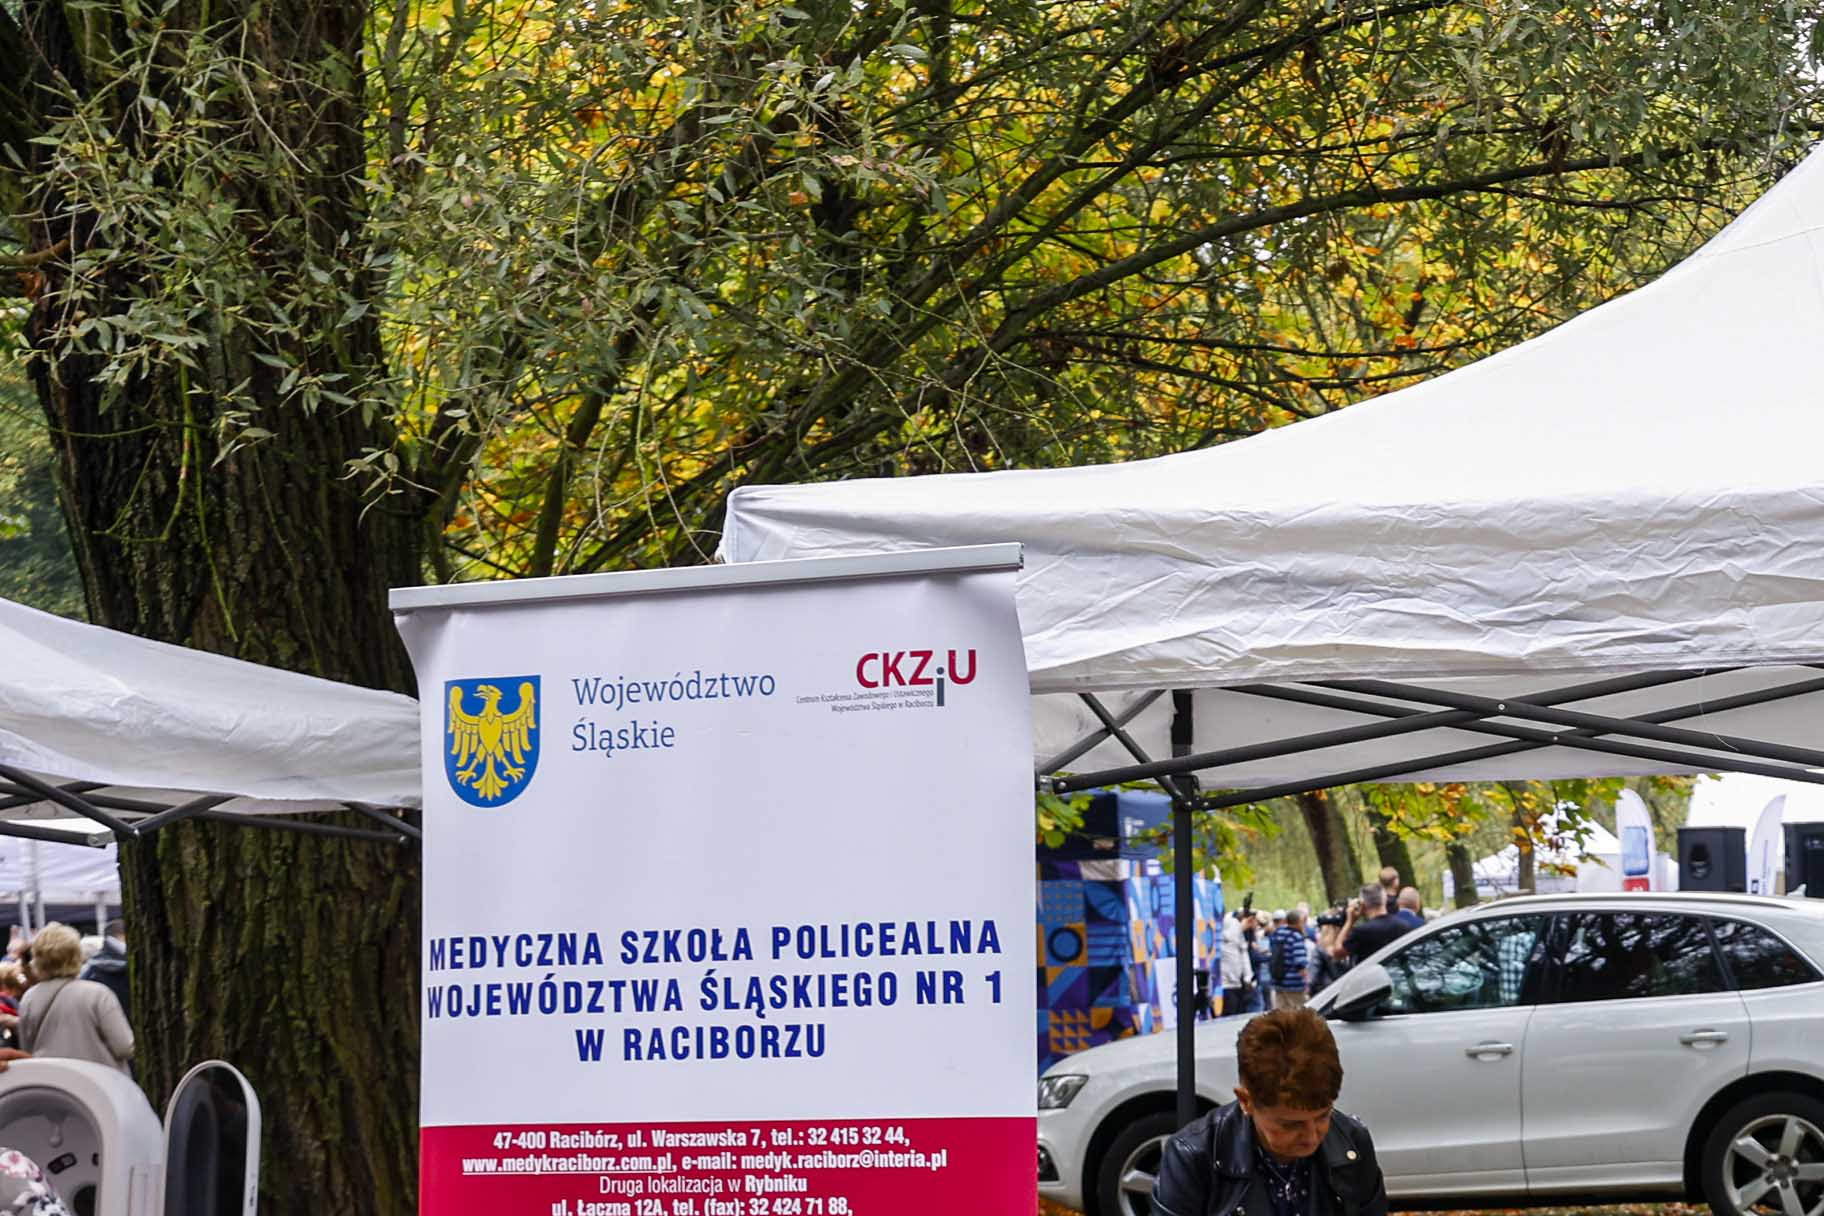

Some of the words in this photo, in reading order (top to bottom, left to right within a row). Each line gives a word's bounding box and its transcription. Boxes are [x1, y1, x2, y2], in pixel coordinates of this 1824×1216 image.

[572, 671, 775, 711] Województwo
[855, 648, 977, 707] CKZiU
[573, 718, 674, 758] Śląskie
[430, 933, 603, 971] MEDYCZNA
[621, 928, 753, 964] SZKOŁA
[772, 920, 1001, 959] POLICEALNA
[428, 973, 682, 1018] WOJEWÓDZTWA
[700, 969, 897, 1019] ŚLĄSKIEGO
[917, 971, 964, 1004] NR
[986, 971, 1000, 1003] 1
[576, 1029, 604, 1061] W
[624, 1024, 824, 1060] RACIBORZU
[494, 1132, 546, 1149] 47-400
[550, 1130, 623, 1150] Racibórz,
[628, 1130, 647, 1147] ul.
[652, 1129, 746, 1147] Warszawska
[750, 1129, 766, 1148] 7,
[771, 1128, 803, 1145] tel.:
[808, 1128, 827, 1145] 32
[830, 1127, 858, 1144] 415
[863, 1127, 881, 1144] 32
[885, 1127, 909, 1146] 44,
[463, 1153, 677, 1175] www.medykraciborz.com.pl,
[682, 1152, 736, 1170] e-mail:
[741, 1149, 947, 1172] medyk.raciborz@interia.pl
[600, 1176, 643, 1197] Druga
[648, 1176, 723, 1196] lokalizacja
[728, 1179, 741, 1192] w
[745, 1174, 807, 1196] Rybniku
[552, 1200, 572, 1216] ul.
[673, 1198, 699, 1216] tel.
[749, 1198, 769, 1215] 32
[773, 1198, 800, 1215] 424
[800, 1198, 822, 1215] 71
[828, 1197, 852, 1216] 88,
